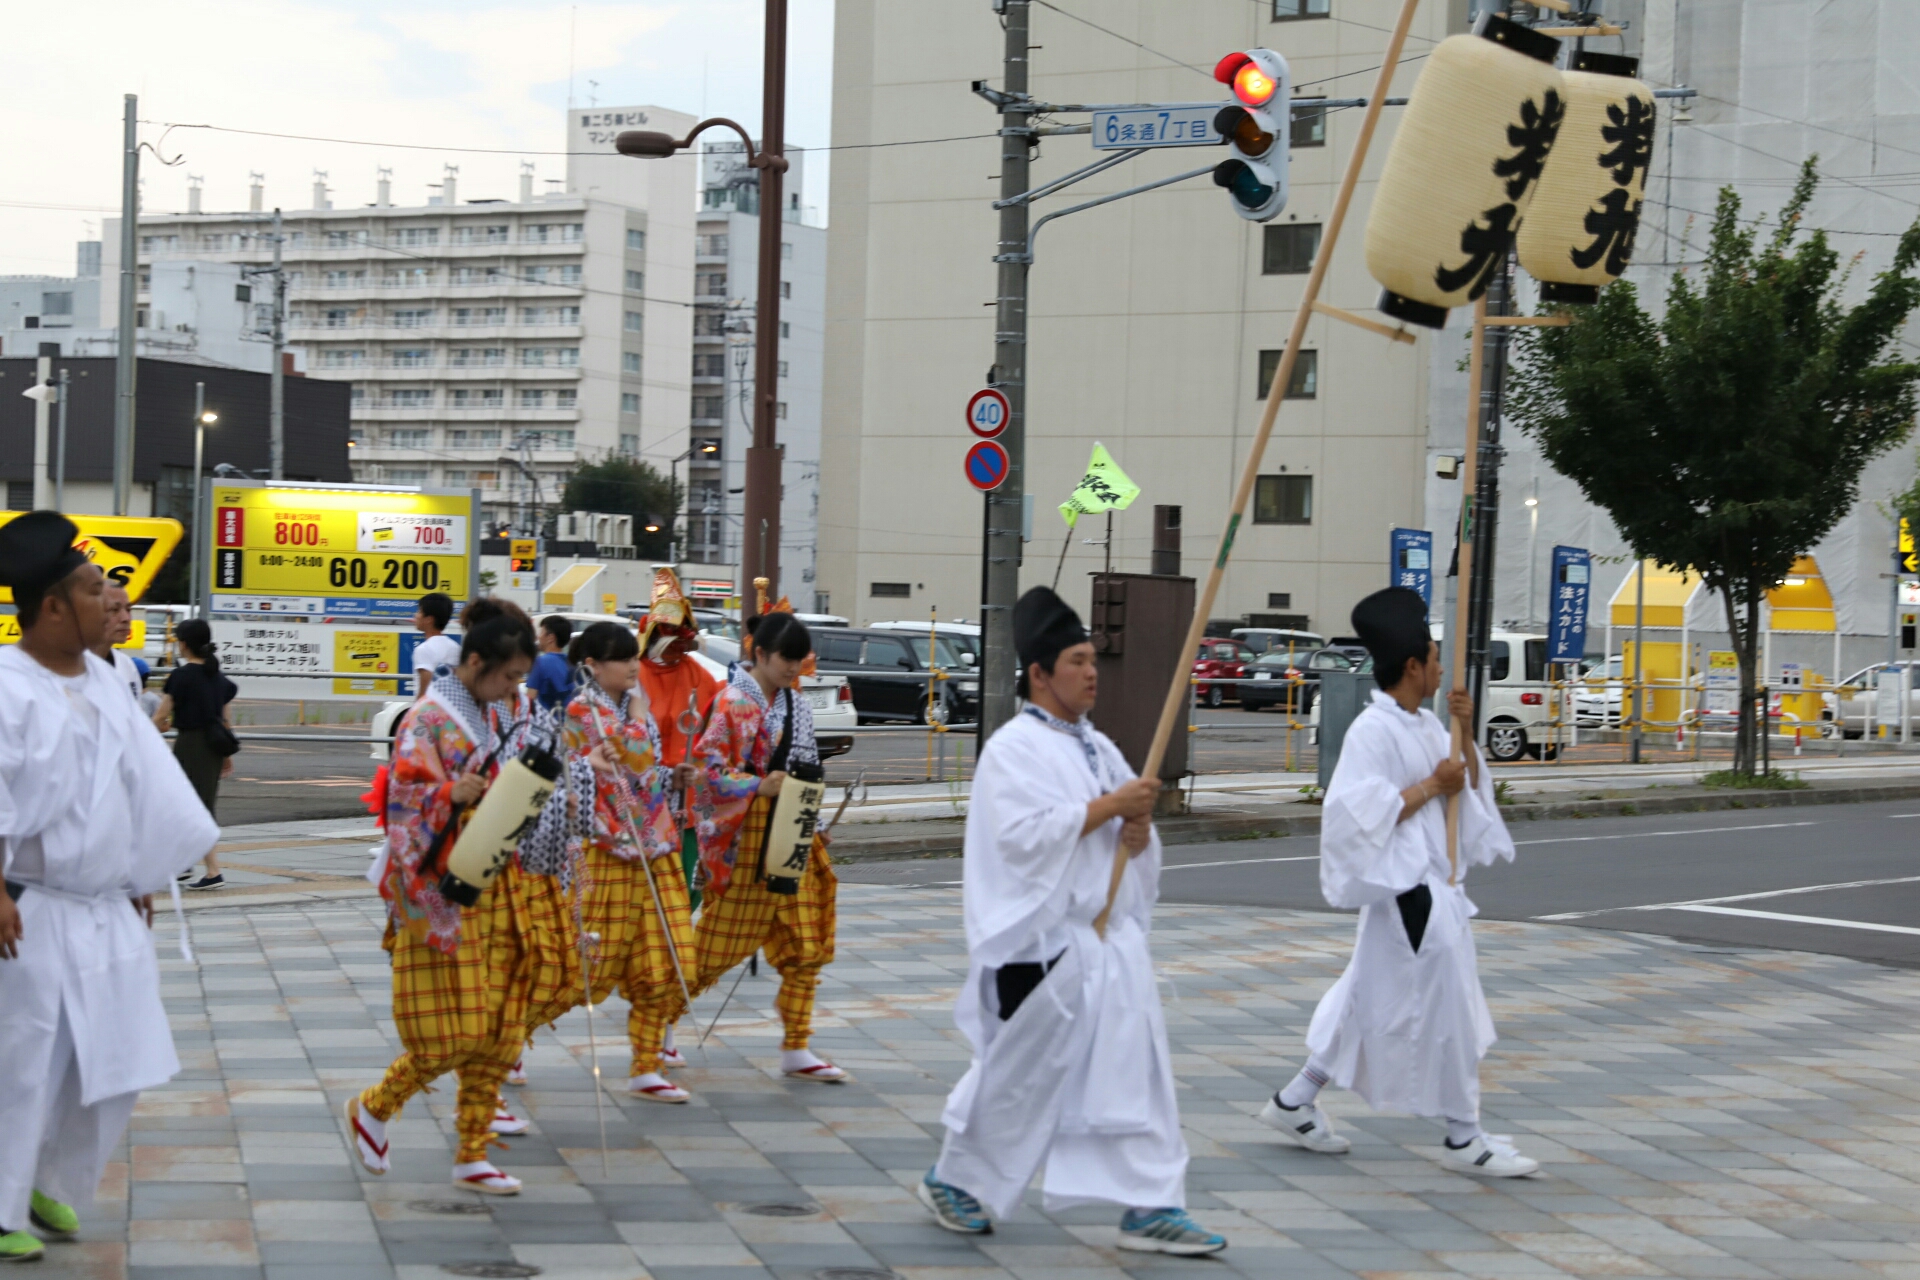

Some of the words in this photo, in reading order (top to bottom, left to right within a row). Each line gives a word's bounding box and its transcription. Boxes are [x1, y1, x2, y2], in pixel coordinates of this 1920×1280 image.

[1106, 112, 1207, 143] 6条通7丁目
[975, 402, 1000, 425] 40
[1556, 586, 1575, 655] 法人カード
[1571, 586, 1587, 635] タイムズの
